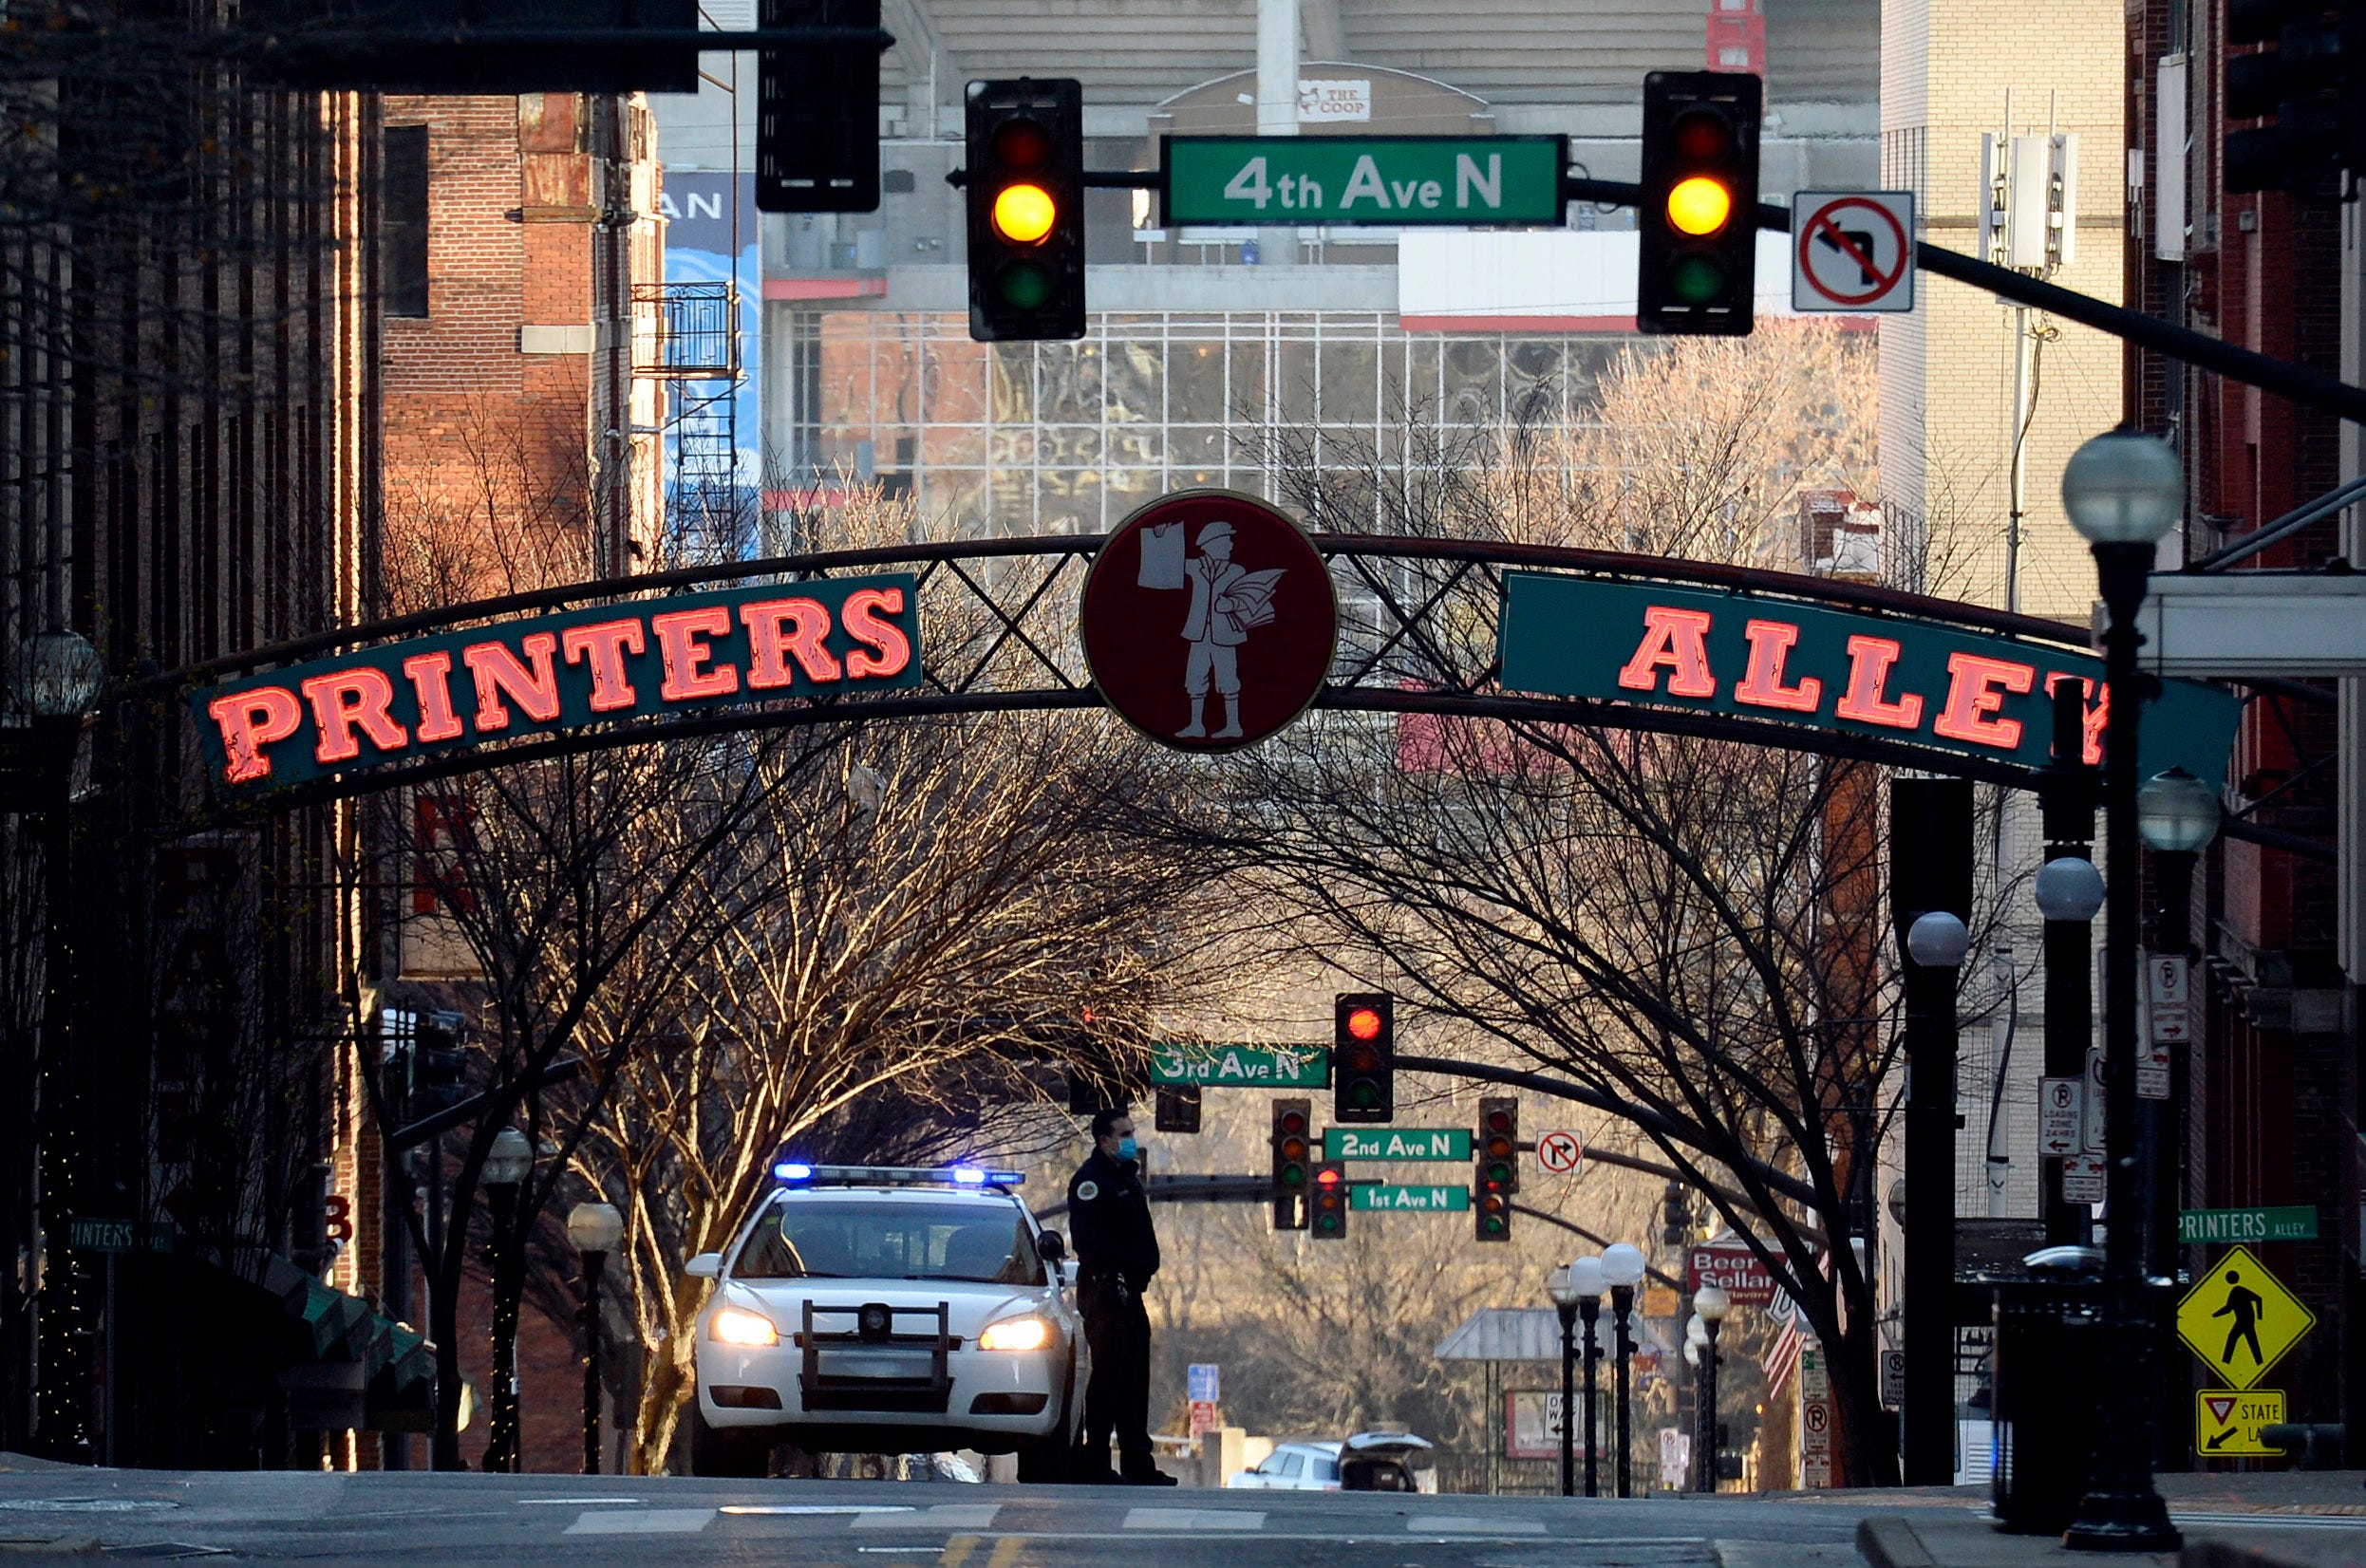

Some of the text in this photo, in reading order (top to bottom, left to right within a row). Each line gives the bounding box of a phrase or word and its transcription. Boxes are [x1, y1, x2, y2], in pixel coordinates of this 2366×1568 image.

[1327, 89, 1357, 102] THE
[1321, 102, 1364, 113] COOP
[1223, 153, 1502, 210] 4th Ave N
[208, 587, 913, 785] PRINTERS
[1164, 1049, 1300, 1080] 3rd Ave N
[1342, 1134, 1451, 1156] 2nd Ave N
[1367, 1187, 1448, 1207] 1st Ave N
[2178, 1212, 2306, 1239] PRINTERS ALLEY
[1694, 1253, 1758, 1270] Beer
[1699, 1271, 1774, 1289] Sellar
[1730, 1291, 1770, 1299] lavors
[2242, 1405, 2280, 1420] STATE
[2247, 1427, 2263, 1442] LA
